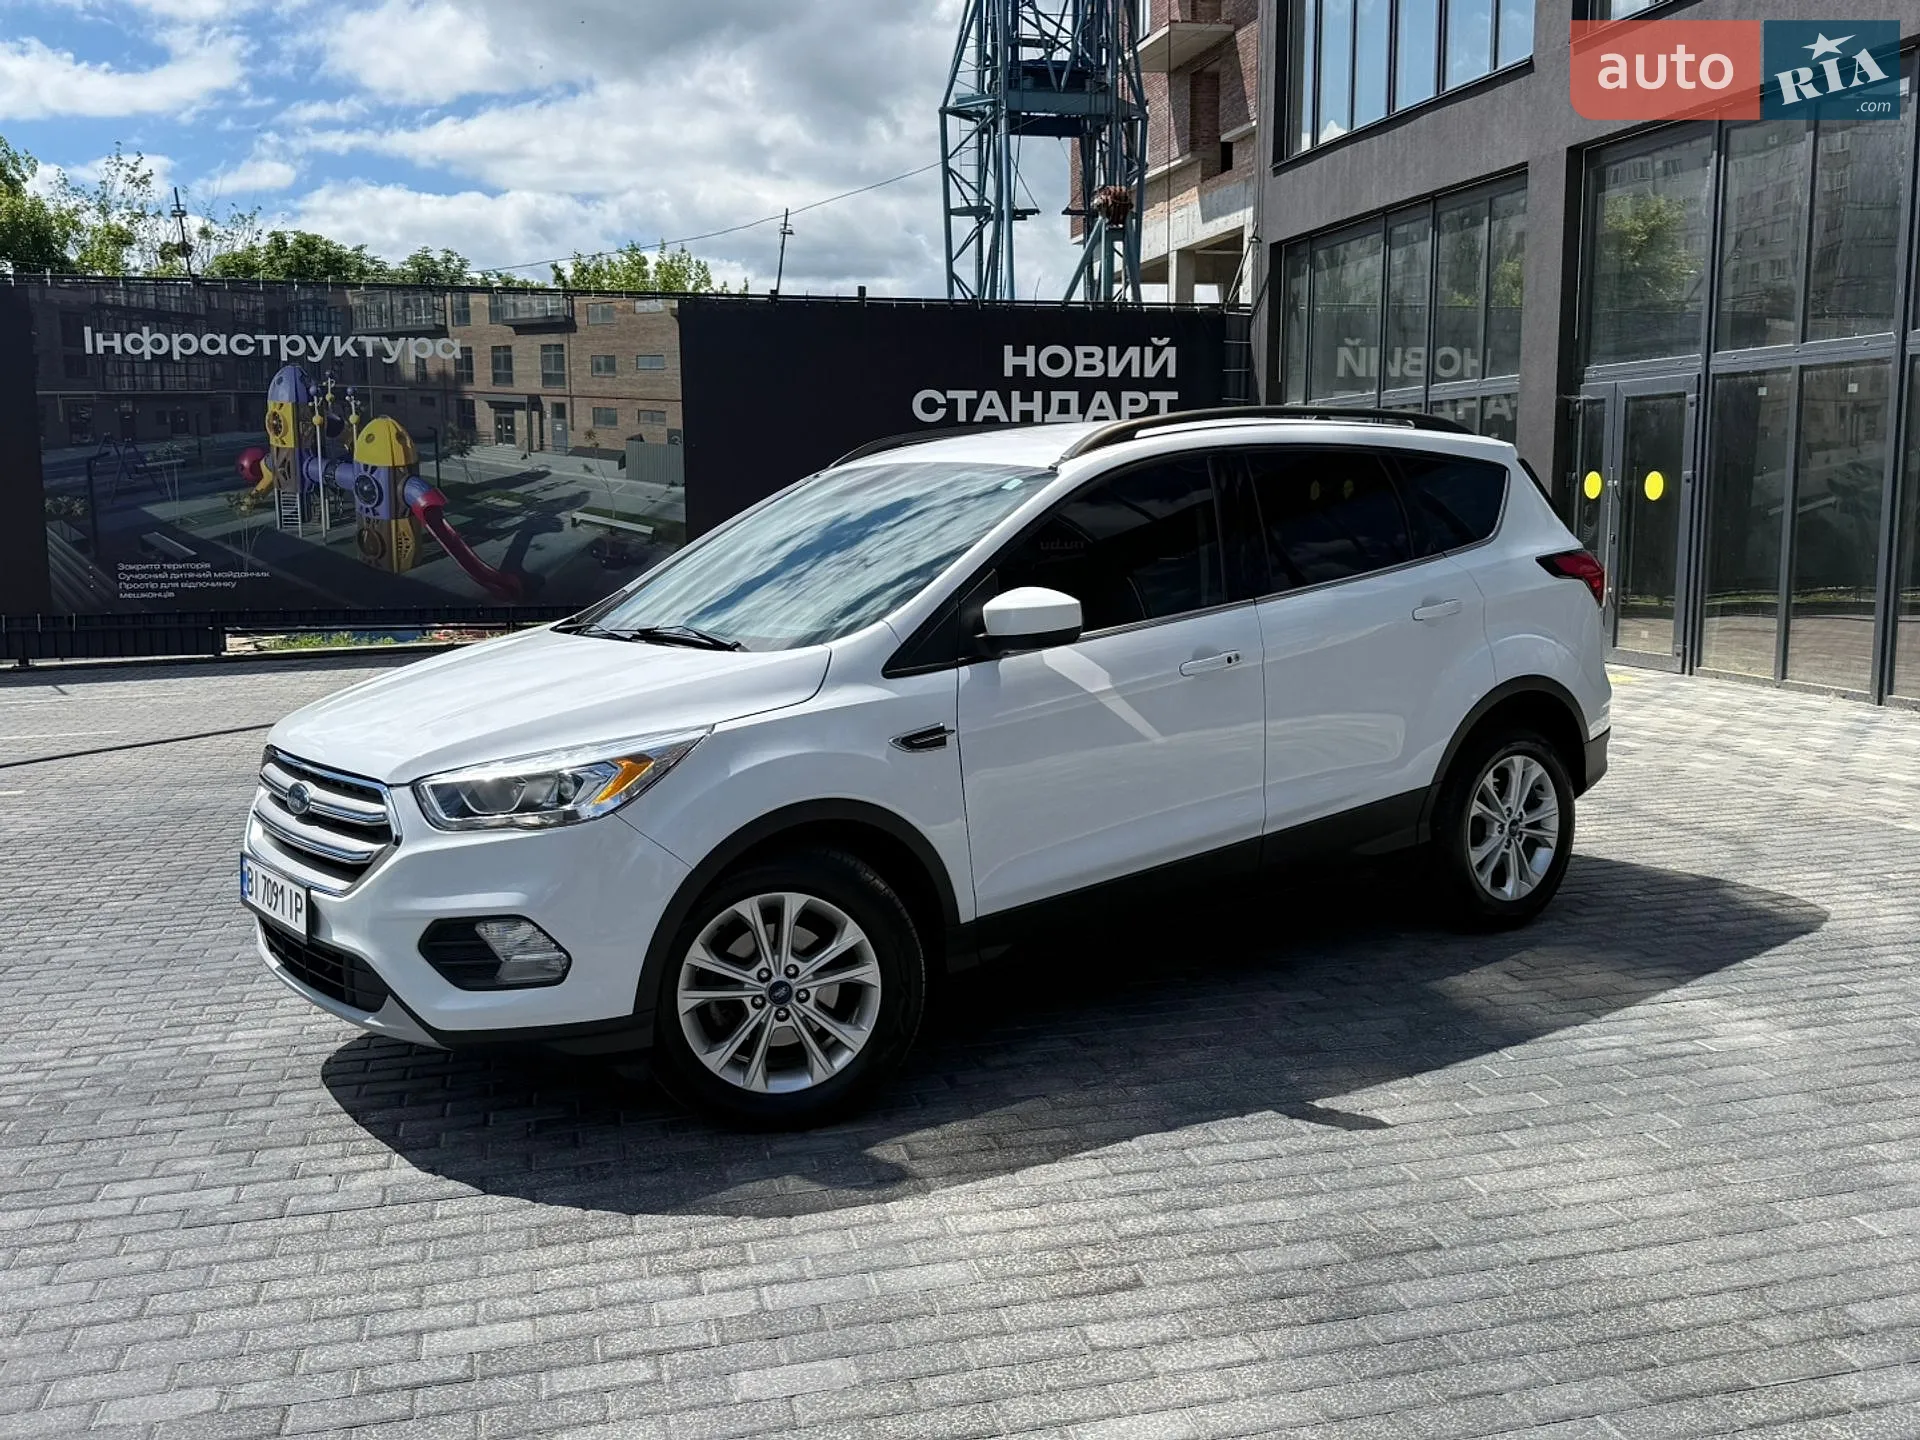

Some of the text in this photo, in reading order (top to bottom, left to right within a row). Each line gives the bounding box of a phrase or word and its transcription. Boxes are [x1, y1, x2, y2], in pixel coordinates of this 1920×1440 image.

[83, 326, 461, 363] Інфраструктура
[1003, 337, 1177, 378] НОВИЙ
[911, 389, 1179, 423] СТАНДАРТ
[261, 874, 285, 916] 7091
[289, 888, 303, 923] IP
